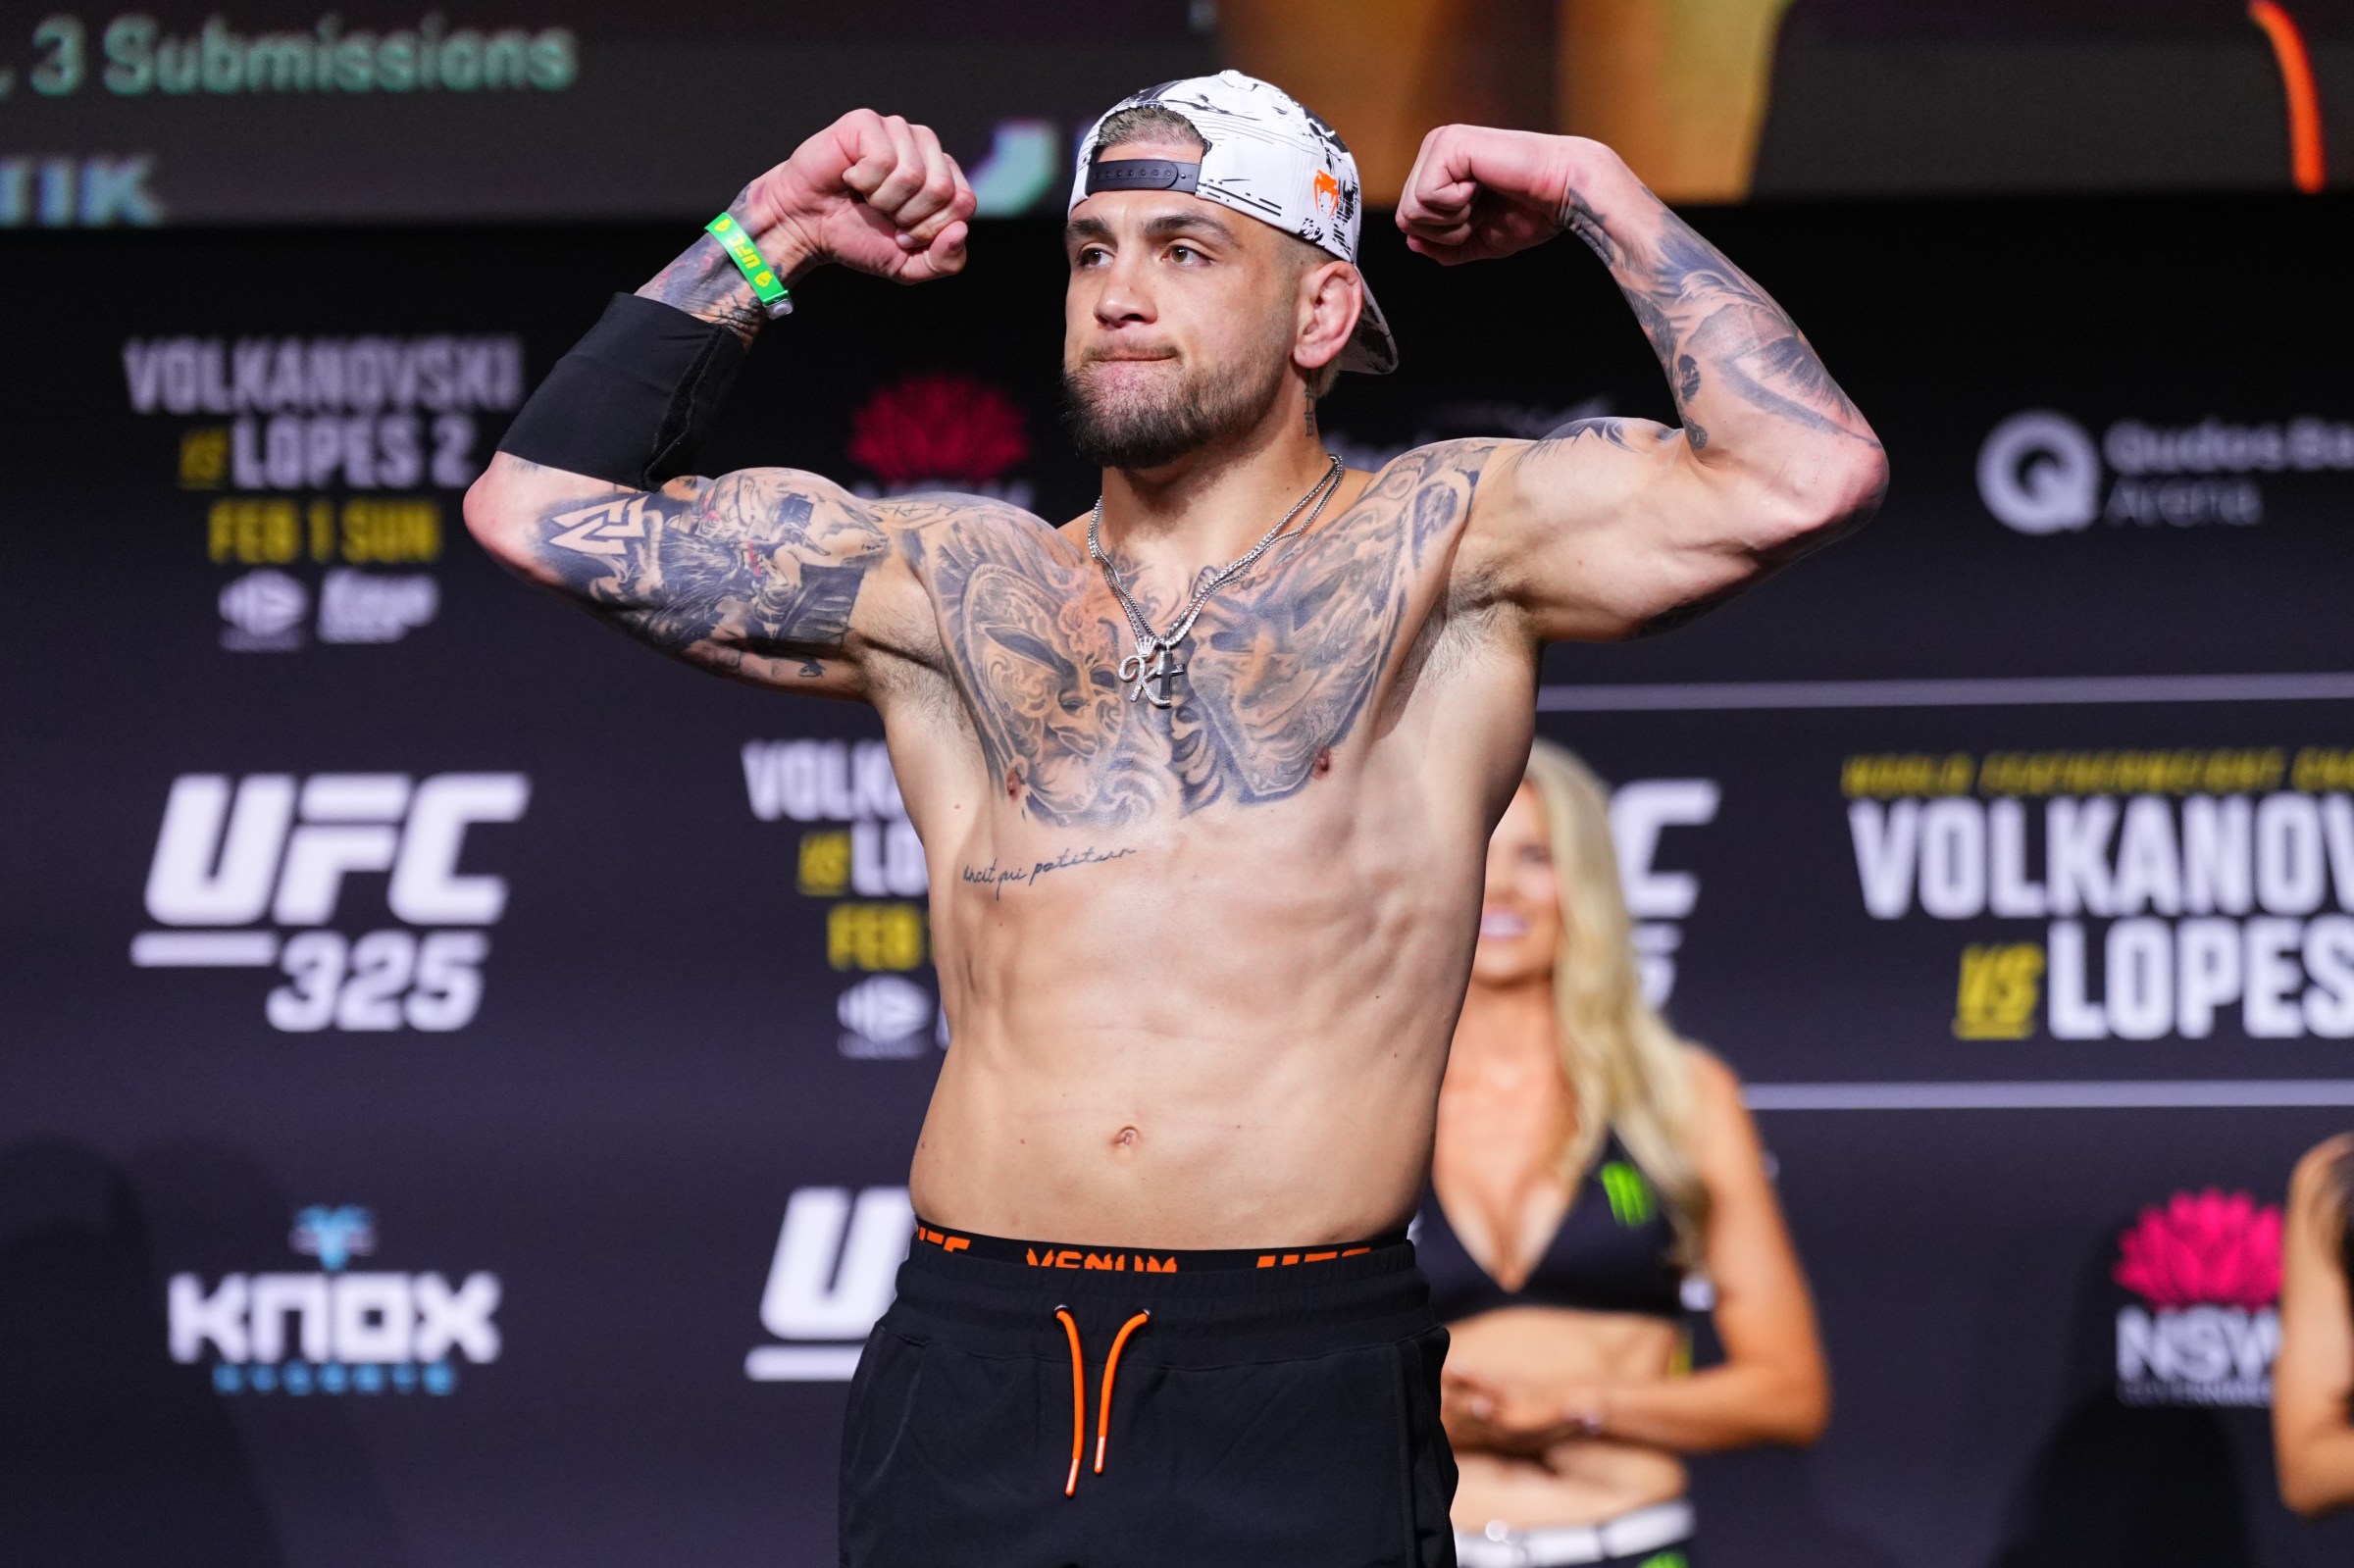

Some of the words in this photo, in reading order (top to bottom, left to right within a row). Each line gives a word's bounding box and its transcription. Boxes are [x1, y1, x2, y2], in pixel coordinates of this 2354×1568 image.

[31, 16, 84, 95] 3
[103, 11, 578, 95] Submissions
[124, 335, 522, 413] VOLKANOVSKI
[232, 416, 422, 487] LOPES
[432, 416, 479, 486] 2
[209, 501, 299, 563] FEB
[309, 502, 333, 562] 1
[343, 502, 439, 562] SUN
[145, 773, 531, 925] UFC
[829, 905, 921, 970] FEB
[2049, 916, 2354, 1039] LOPES
[266, 930, 488, 1033] 325
[168, 1272, 501, 1364] KNOX
